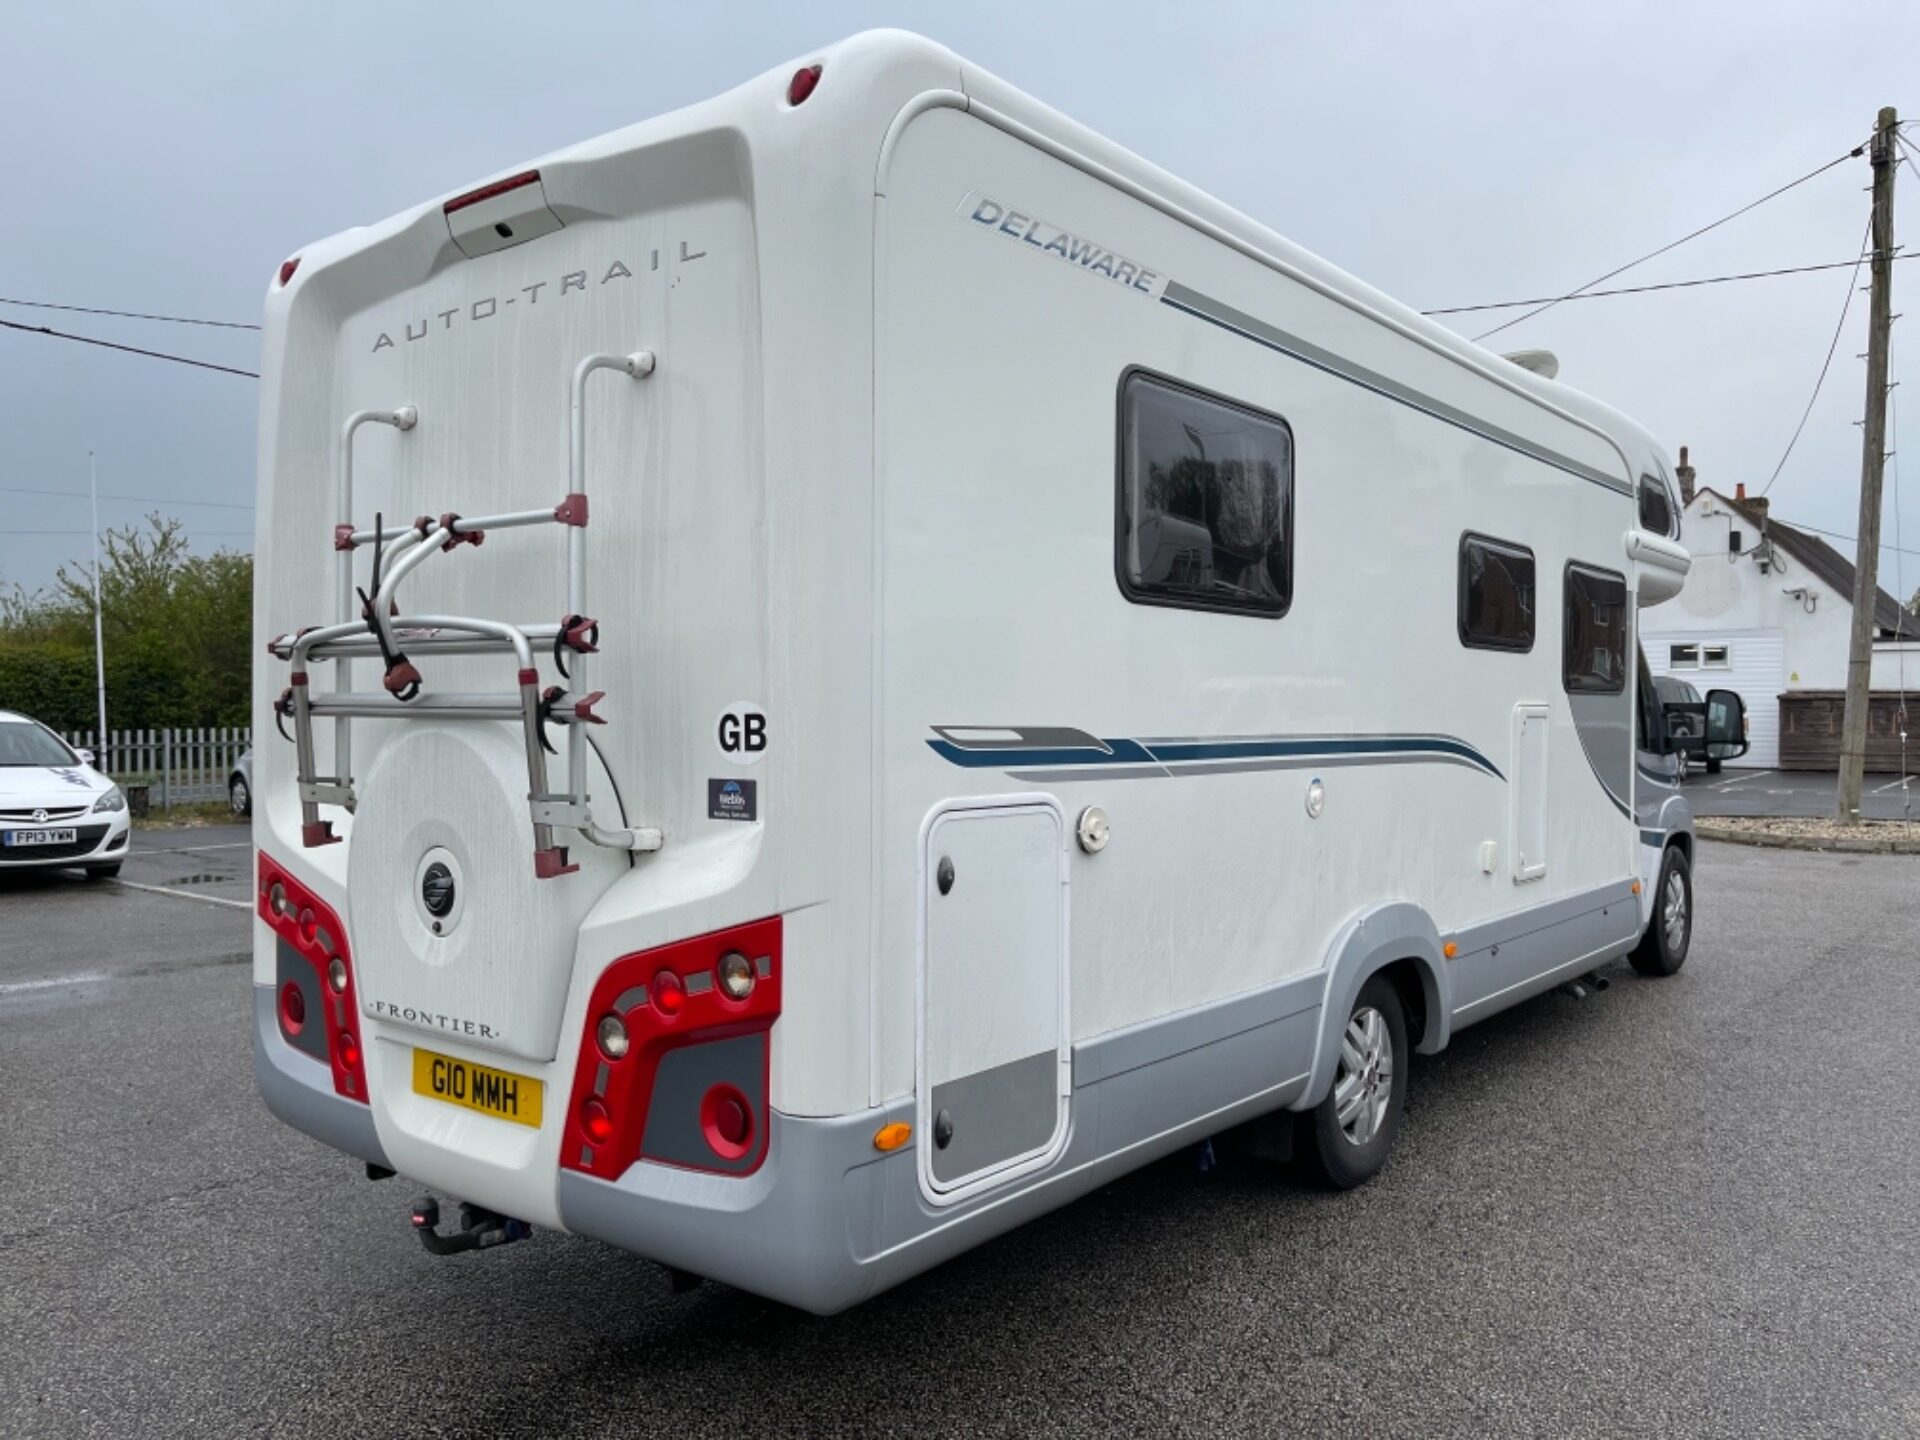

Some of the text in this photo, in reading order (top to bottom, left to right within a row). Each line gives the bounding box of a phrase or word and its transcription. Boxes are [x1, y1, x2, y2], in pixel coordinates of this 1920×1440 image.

[971, 198, 1157, 292] DELAWARE
[372, 241, 706, 352] AUTO-TRAIL
[718, 713, 766, 752] GB
[16, 831, 46, 843] FP13
[376, 1001, 494, 1038] FRONTIER
[431, 1058, 518, 1115] G10 MMH
